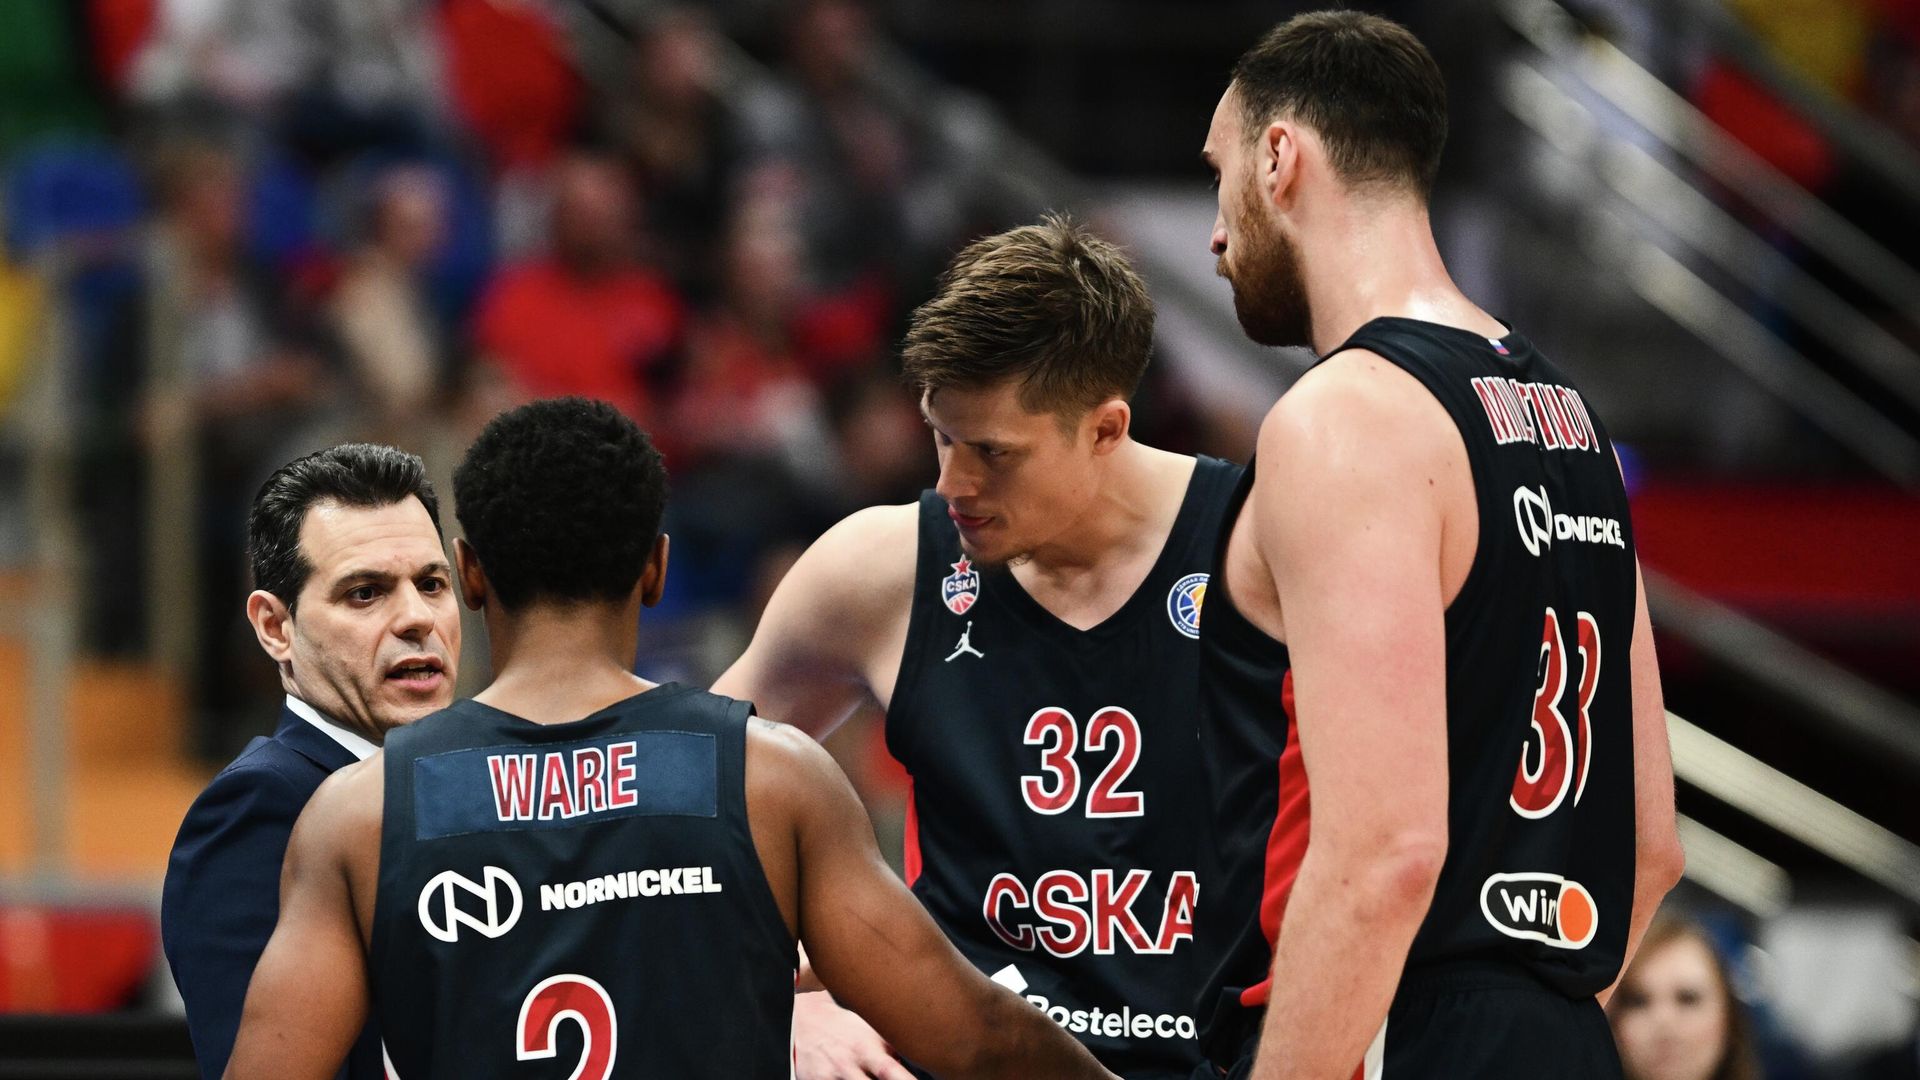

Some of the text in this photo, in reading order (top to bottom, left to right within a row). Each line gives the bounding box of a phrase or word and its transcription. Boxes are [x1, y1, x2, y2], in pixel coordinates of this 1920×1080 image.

[946, 577, 976, 592] CSKA
[487, 741, 638, 821] WARE
[1020, 706, 1144, 818] 32
[540, 866, 722, 911] NORNICKEL
[983, 869, 1200, 958] CSKA
